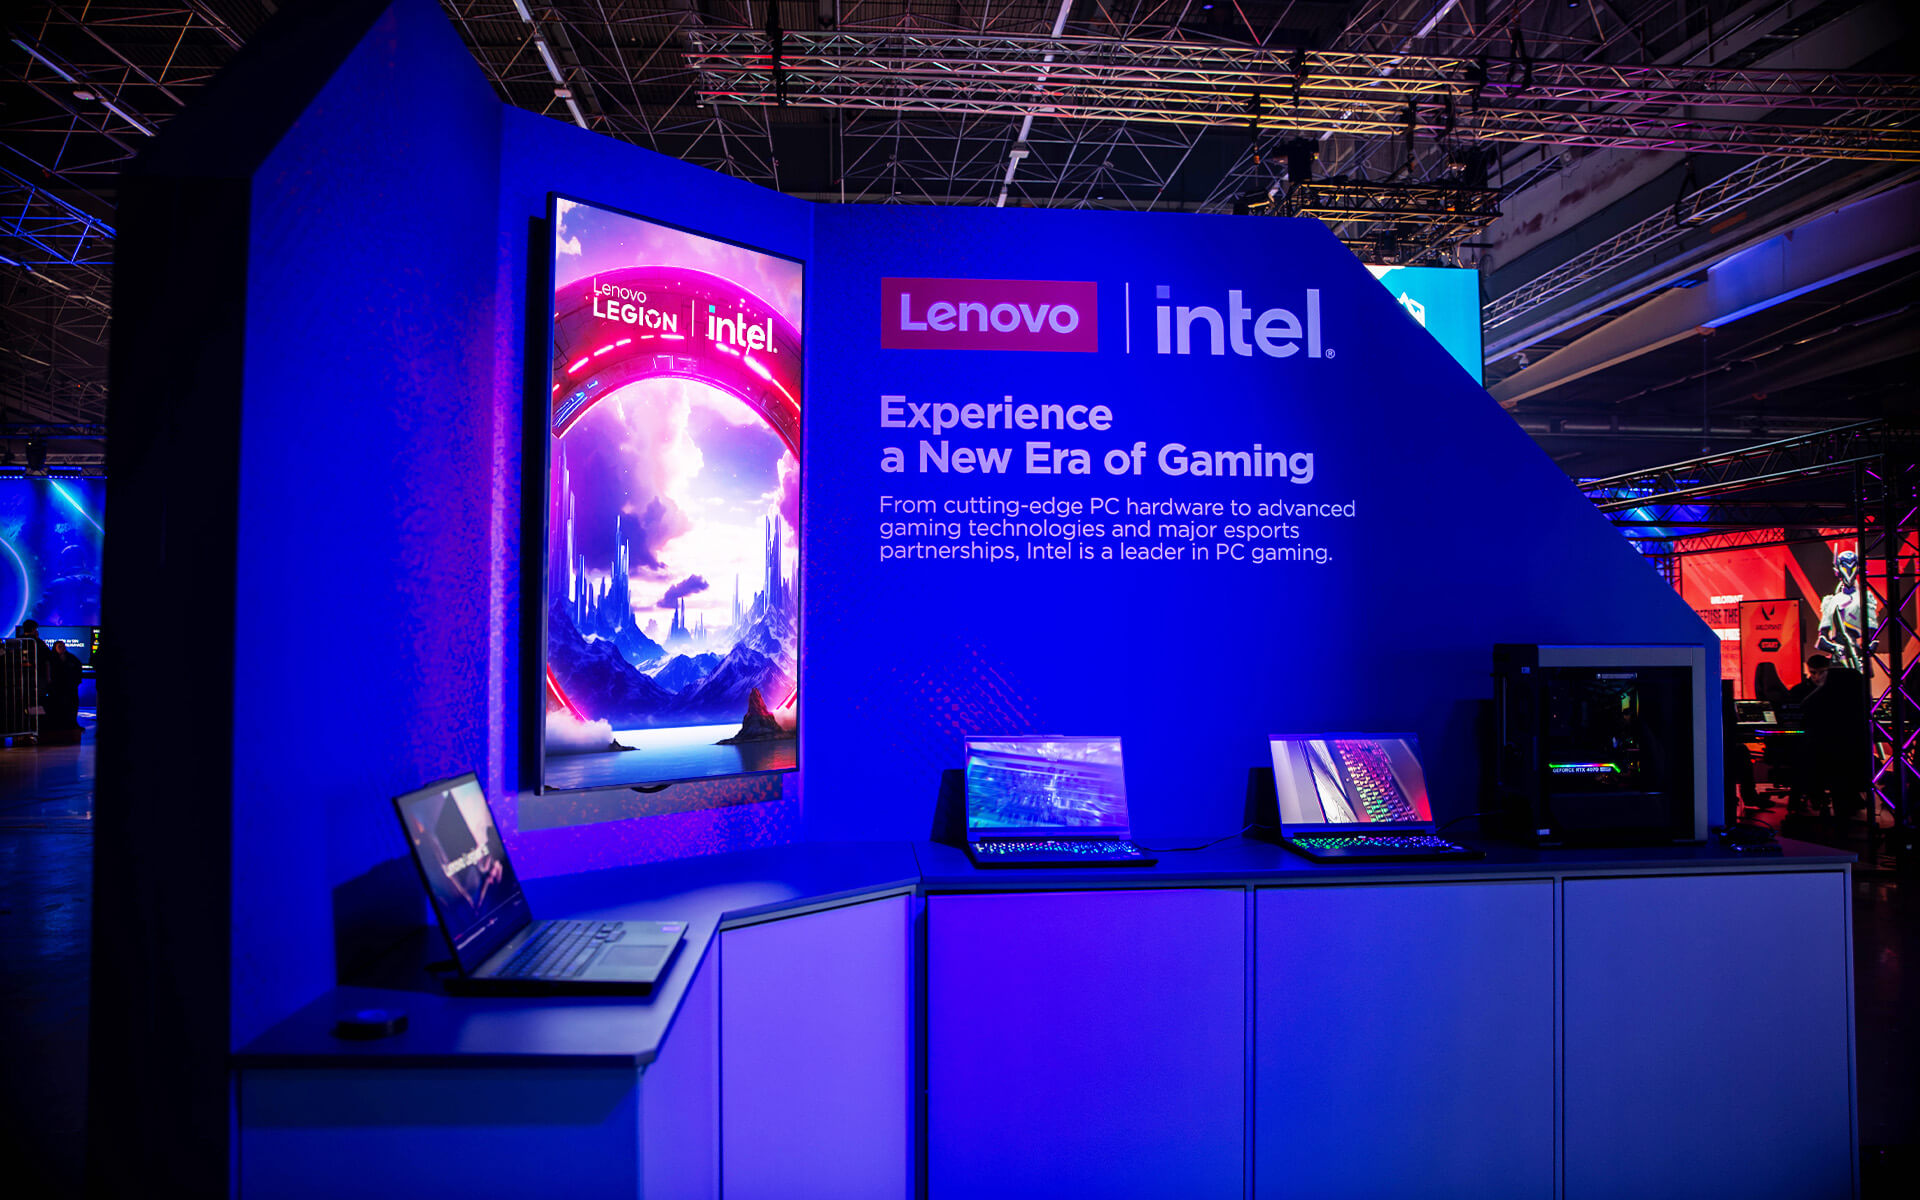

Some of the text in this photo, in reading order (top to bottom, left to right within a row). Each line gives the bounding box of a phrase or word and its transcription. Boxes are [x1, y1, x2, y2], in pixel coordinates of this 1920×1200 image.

[593, 277, 647, 303] Lenovo
[593, 297, 678, 333] LEGION
[900, 293, 1080, 334] Lenovo
[880, 395, 1113, 436] Experience
[880, 440, 1314, 485] a New Era of Gaming
[880, 496, 1356, 519] From cutting-edge PC hardware to advanced
[880, 519, 1300, 543] gaming technologies and major esports
[880, 541, 1333, 565] partnerships, Intel is a leader in PC gaming.
